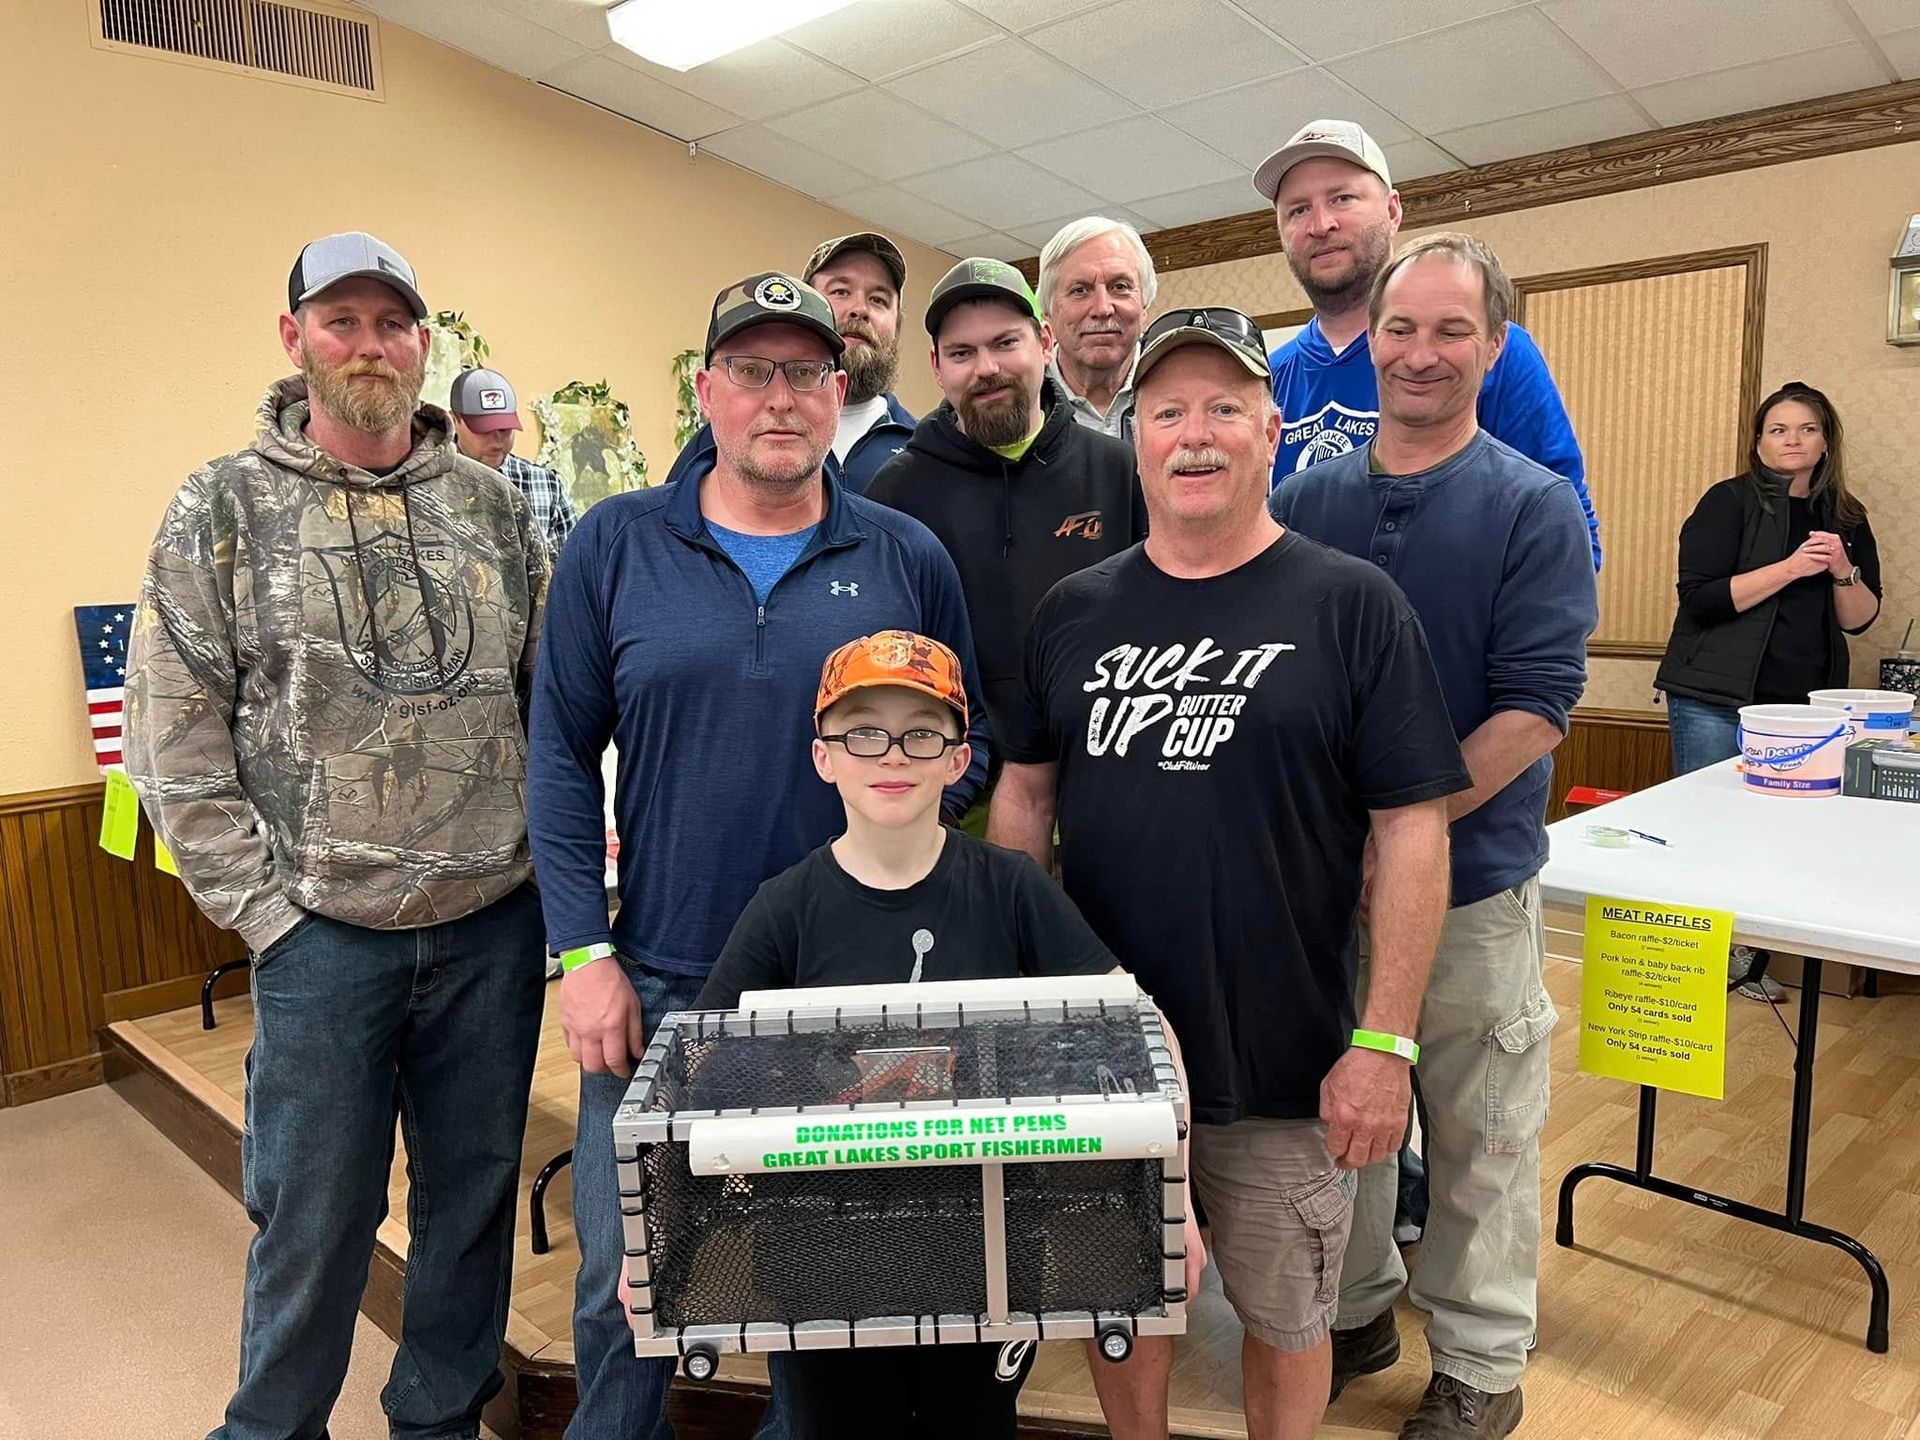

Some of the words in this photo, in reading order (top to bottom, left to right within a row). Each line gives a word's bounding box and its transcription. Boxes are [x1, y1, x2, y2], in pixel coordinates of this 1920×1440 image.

[1285, 416, 1325, 445] GREAT
[1334, 415, 1376, 436] LAKES
[1308, 431, 1349, 452] OZAUKEE
[1083, 637, 1224, 692] SUCK
[1220, 643, 1296, 688] IT
[1087, 693, 1174, 757] UP
[1175, 694, 1247, 716] BUTTER
[1161, 717, 1235, 757] CUP
[1763, 778, 1790, 789] Family
[1792, 780, 1811, 789] Size
[1602, 907, 1640, 921] MEAT
[1644, 911, 1711, 930] RAFFLES
[1610, 930, 1637, 941] Bacon
[1638, 935, 1699, 949] raffle-$2/ticket
[1601, 953, 1620, 963] Pork
[1622, 955, 1637, 965] loin
[1639, 958, 1646, 967] &
[1647, 959, 1668, 971] baby
[1670, 961, 1692, 973] back
[1694, 966, 1706, 975] rib
[1621, 968, 1681, 984] raffle-$2/ticket
[1604, 989, 1633, 1002] Ribeye
[1635, 995, 1698, 1012] raffle-$10/card
[1608, 1002, 1628, 1014] Only
[1630, 1005, 1642, 1015] 54
[1643, 1009, 1669, 1020] cards
[1671, 1013, 1692, 1023] sold
[1588, 1022, 1606, 1032] New
[1608, 1026, 1626, 1036] York
[1628, 1029, 1648, 1041] Strip
[1649, 1034, 1713, 1052] raffle-$10/card
[1606, 1038, 1627, 1050] Only
[1629, 1042, 1640, 1051] 54
[1641, 1045, 1667, 1057] cards
[1670, 1049, 1691, 1060] sold
[796, 1121, 918, 1145] DONATIONS
[924, 1118, 964, 1137] FOR
[970, 1116, 1007, 1135] NET
[1013, 1113, 1067, 1133] PENS
[762, 1149, 829, 1169] GREAT
[834, 1146, 901, 1165] LAKES
[905, 1141, 976, 1161] SPORT
[982, 1136, 1103, 1157] FISHERMEN
